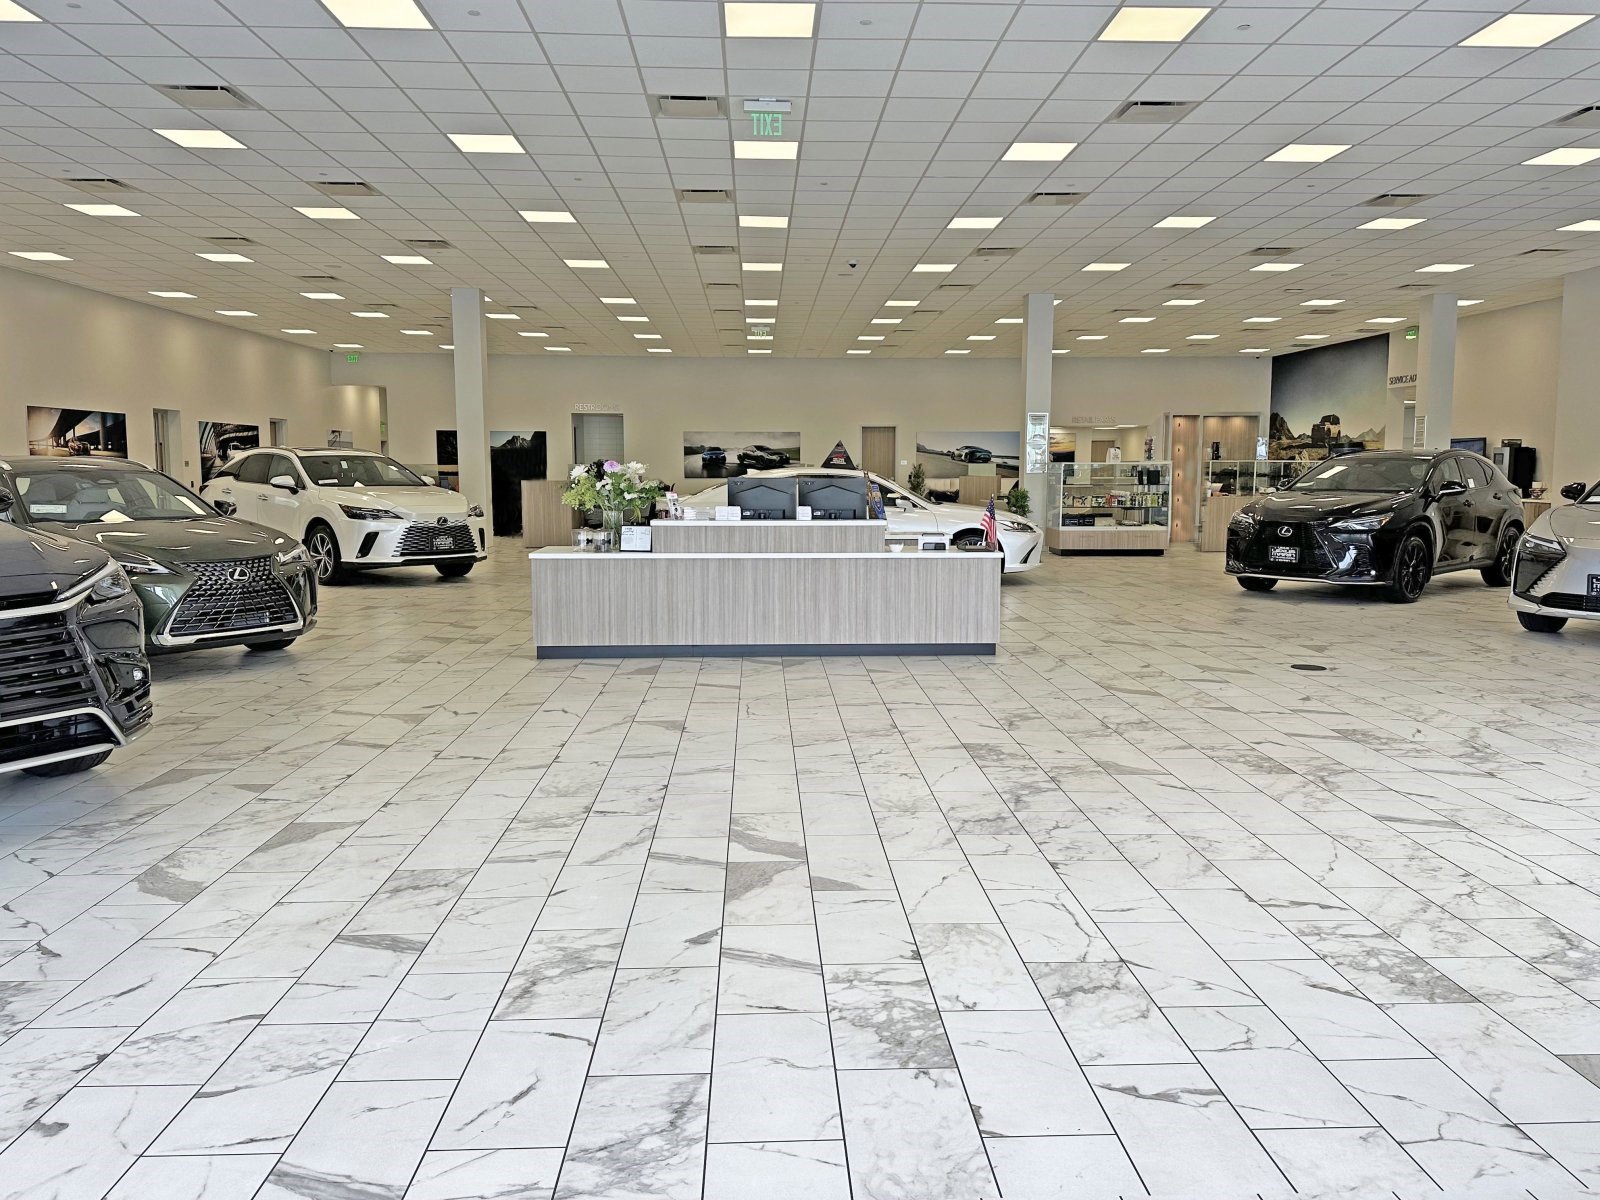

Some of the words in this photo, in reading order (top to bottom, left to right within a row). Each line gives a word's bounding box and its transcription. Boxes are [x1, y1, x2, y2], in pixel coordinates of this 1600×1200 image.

[347, 355, 359, 363] EXIT
[1389, 375, 1409, 385] SERVICE
[574, 403, 622, 411] RESTRO
